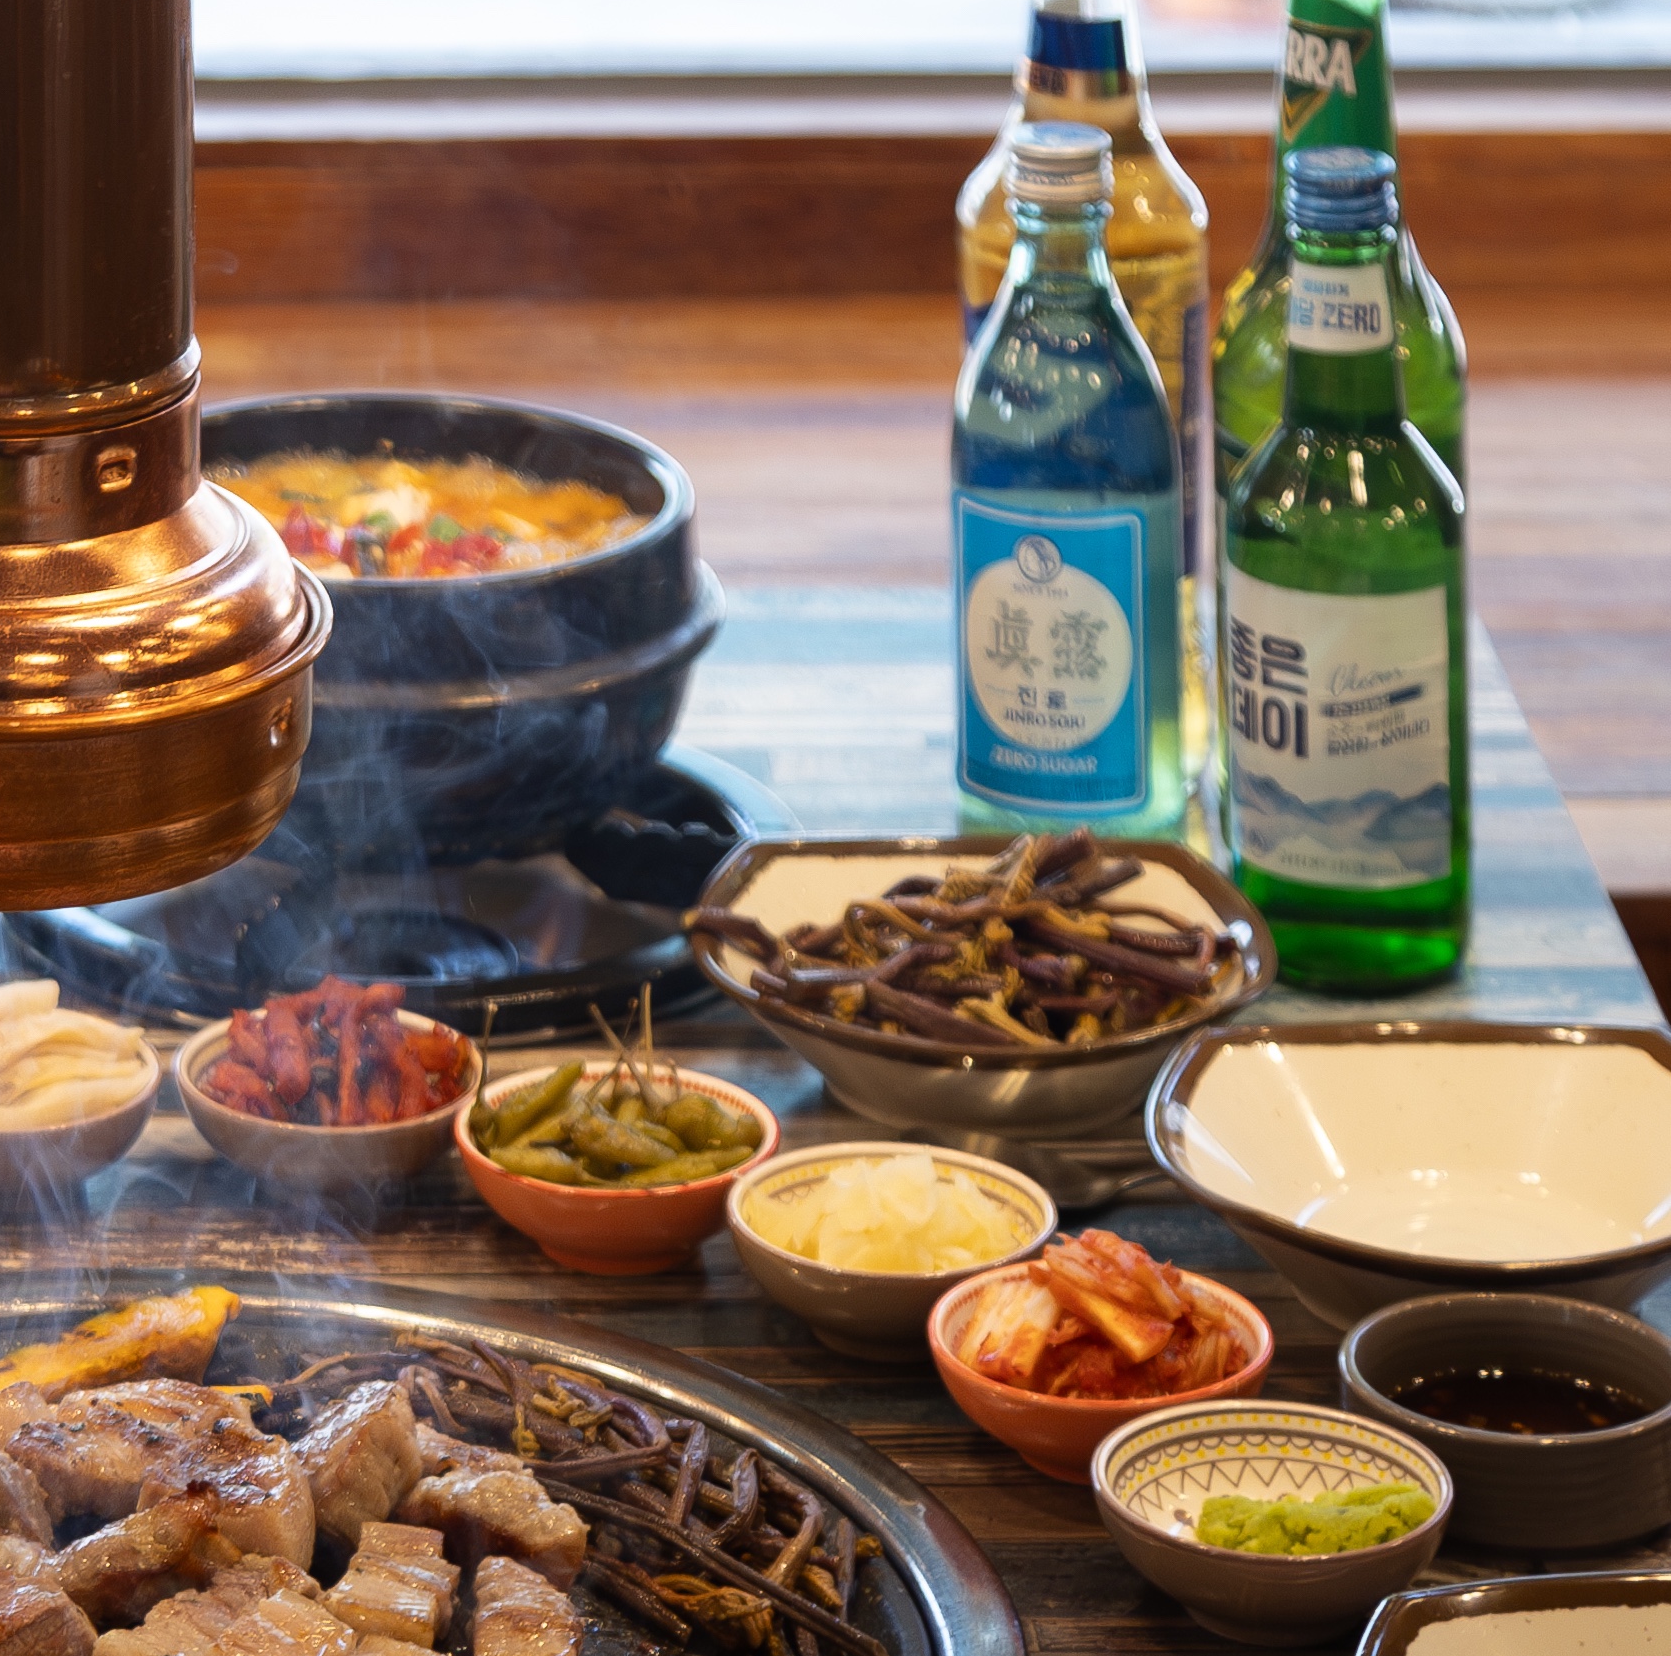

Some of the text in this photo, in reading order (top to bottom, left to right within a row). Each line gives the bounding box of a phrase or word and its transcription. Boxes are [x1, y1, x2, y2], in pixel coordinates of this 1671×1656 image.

[1285, 27, 1358, 97] RRA
[1322, 301, 1381, 335] ZERO
[1005, 708, 1086, 729] JINRO SOJU
[990, 744, 1098, 775] ZERO SUGAR
